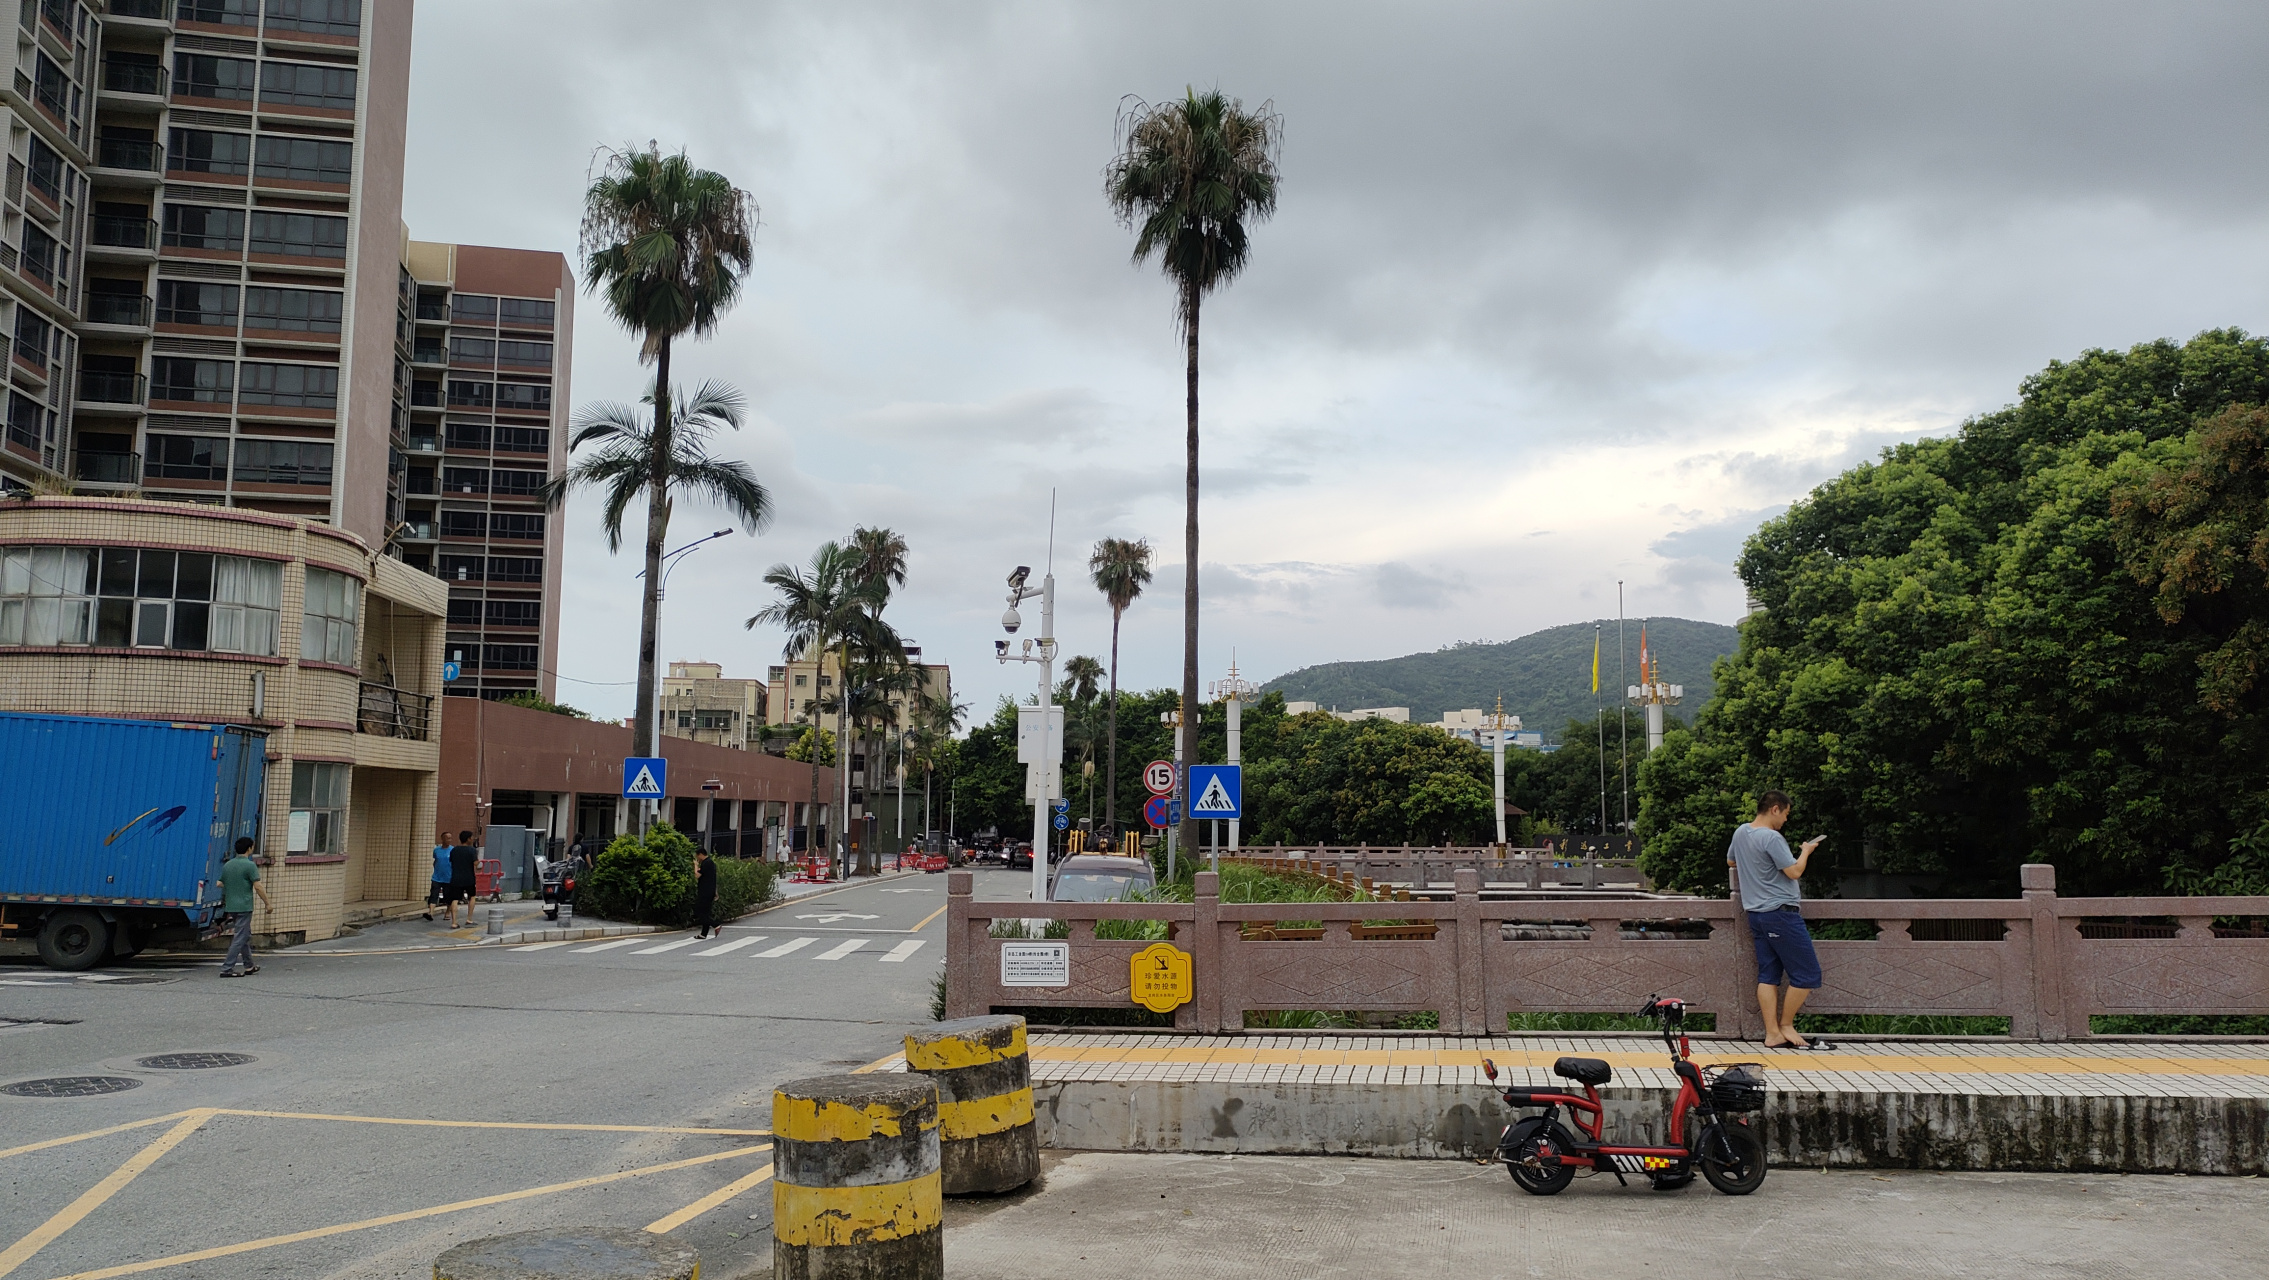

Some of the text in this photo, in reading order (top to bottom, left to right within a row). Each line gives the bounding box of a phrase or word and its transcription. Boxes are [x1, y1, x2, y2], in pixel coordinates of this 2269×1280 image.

[1150, 769, 1170, 786] 15
[1144, 972, 1177, 980] 珍爱水源
[1144, 982, 1178, 991] 请勿投物
